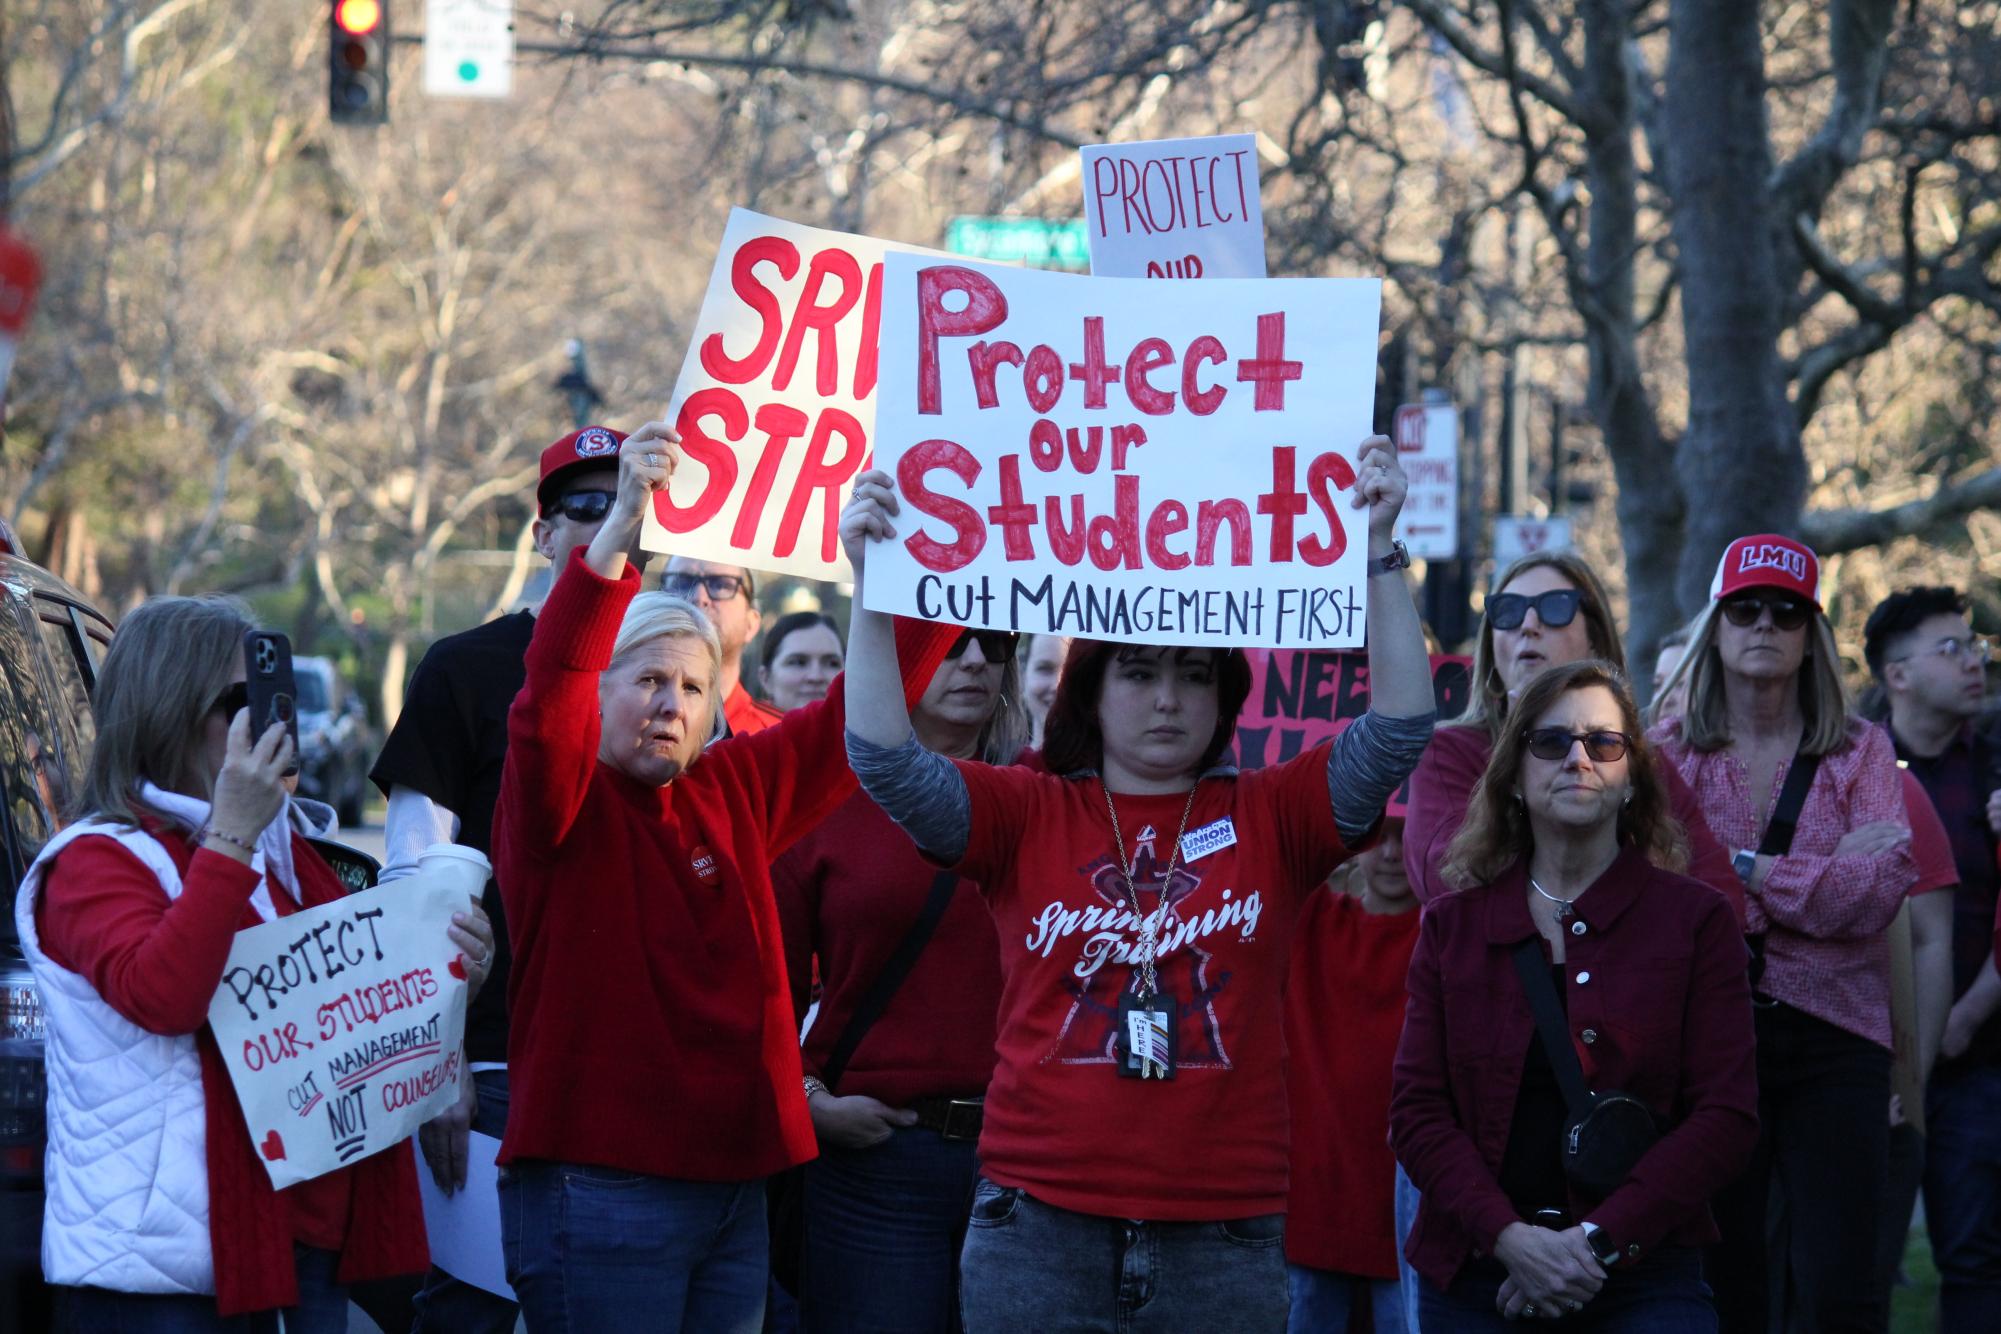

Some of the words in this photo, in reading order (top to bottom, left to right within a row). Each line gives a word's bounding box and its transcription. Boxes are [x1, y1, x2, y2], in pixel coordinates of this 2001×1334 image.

[1094, 150, 1248, 238] PROTECT
[917, 265, 1303, 416] Protect
[653, 387, 873, 563] STR
[1029, 418, 1148, 475] our
[1739, 544, 1807, 581] LMU
[1182, 824, 1232, 850] UNION
[1185, 833, 1233, 859] STRONG
[223, 907, 384, 1021] PROTECT
[1026, 901, 1169, 958] Spring
[1073, 889, 1263, 978] Training
[243, 1022, 315, 1072] OUR
[317, 968, 438, 1041] STUDENTS
[287, 1071, 321, 1111] CUT
[328, 1013, 441, 1082] MANAGEMENT
[326, 1083, 367, 1140] NOT
